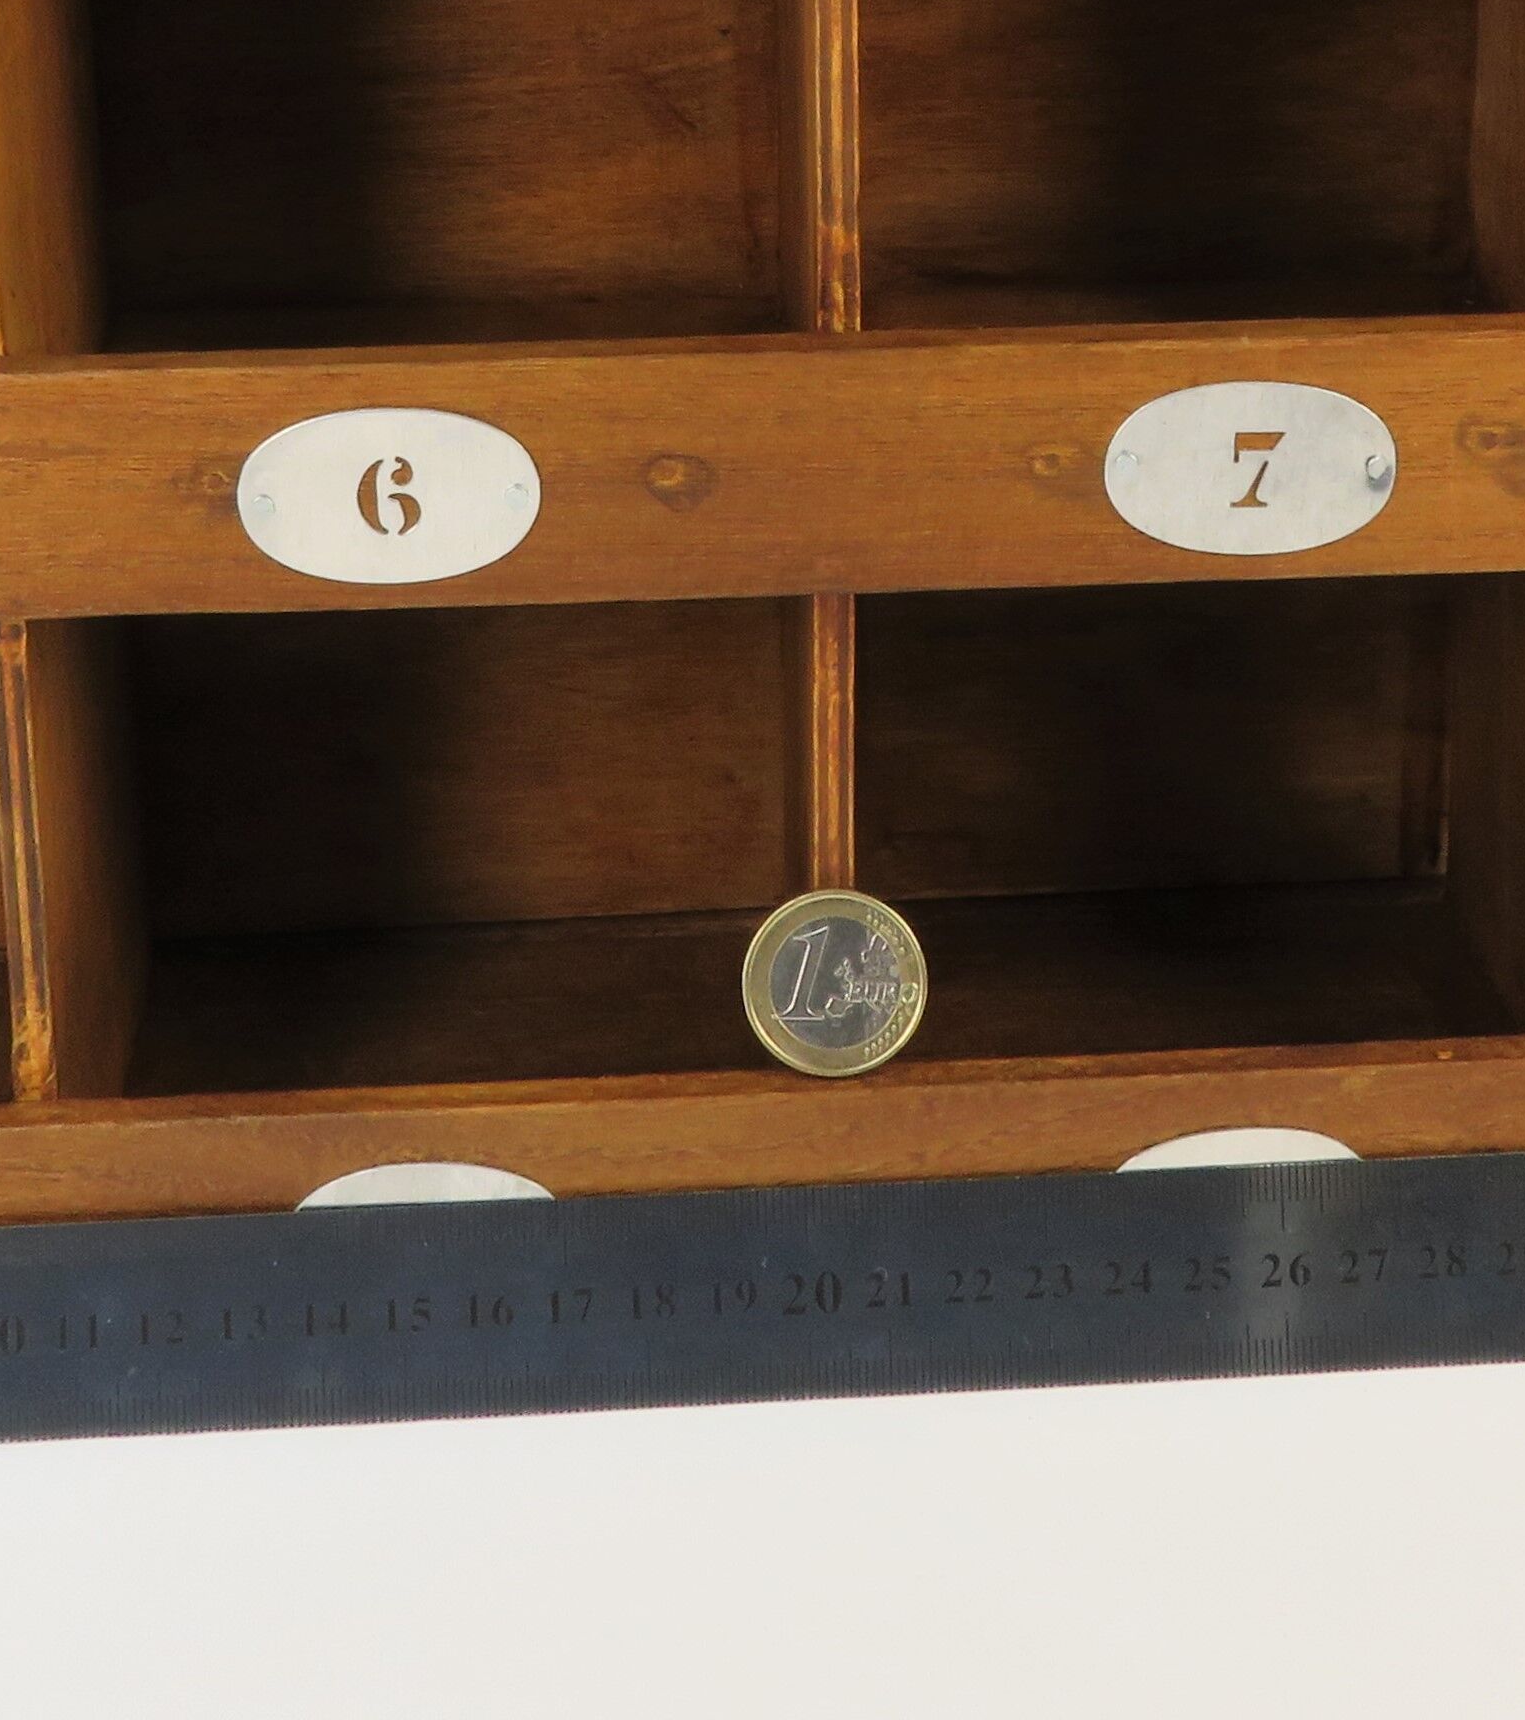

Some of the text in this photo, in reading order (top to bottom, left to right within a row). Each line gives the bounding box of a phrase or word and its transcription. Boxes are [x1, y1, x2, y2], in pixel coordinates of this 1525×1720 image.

[357, 455, 422, 536] 6
[1230, 432, 1287, 508] 7
[772, 926, 830, 1021] 1
[56, 1313, 100, 1350] 11
[137, 1310, 185, 1347] 12
[220, 1305, 269, 1342] 13
[302, 1301, 350, 1338] 14
[385, 1297, 431, 1333] 15
[467, 1293, 514, 1329] 16
[547, 1289, 593, 1325] 17
[629, 1283, 675, 1321] 18
[710, 1279, 756, 1315] 19
[783, 1271, 844, 1316] 20
[866, 1270, 913, 1308] 21
[944, 1268, 994, 1305] 22
[1024, 1264, 1073, 1300] 23
[1104, 1260, 1151, 1296] 24
[1183, 1255, 1231, 1294] 25
[1260, 1252, 1311, 1289] 26
[1339, 1246, 1388, 1283] 27
[1418, 1242, 1468, 1278] 28
